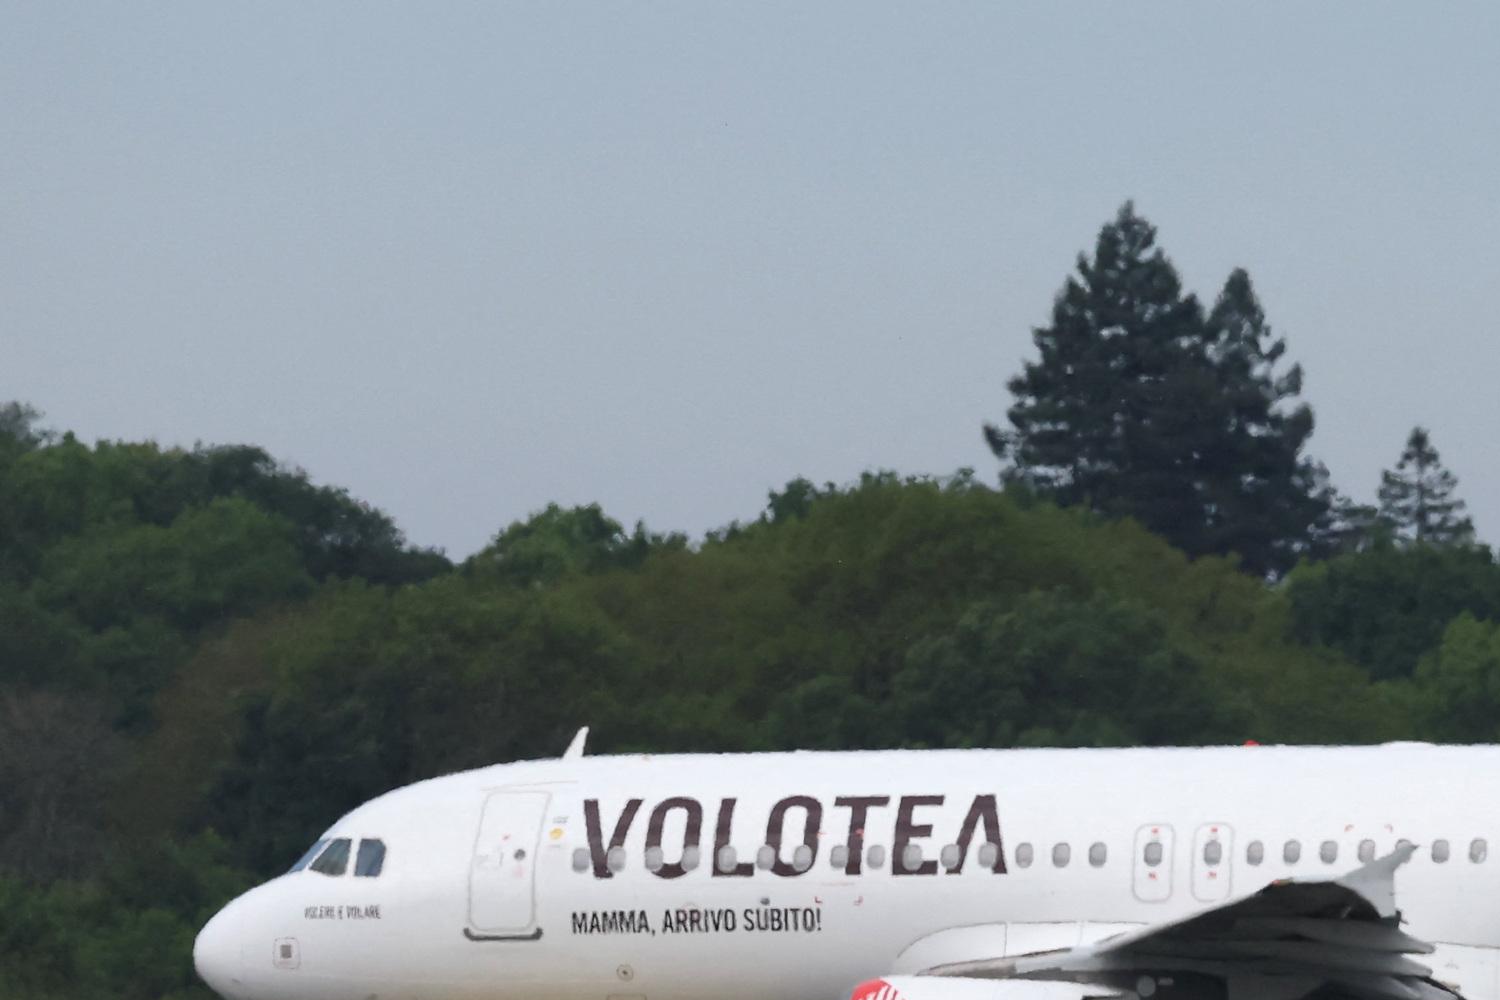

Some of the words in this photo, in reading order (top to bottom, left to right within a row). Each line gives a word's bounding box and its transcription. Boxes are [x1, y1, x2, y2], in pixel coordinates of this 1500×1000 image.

[583, 794, 1008, 879] VOLOTEA
[571, 909, 656, 936] MAMMA,
[662, 908, 736, 933] ARRIVO
